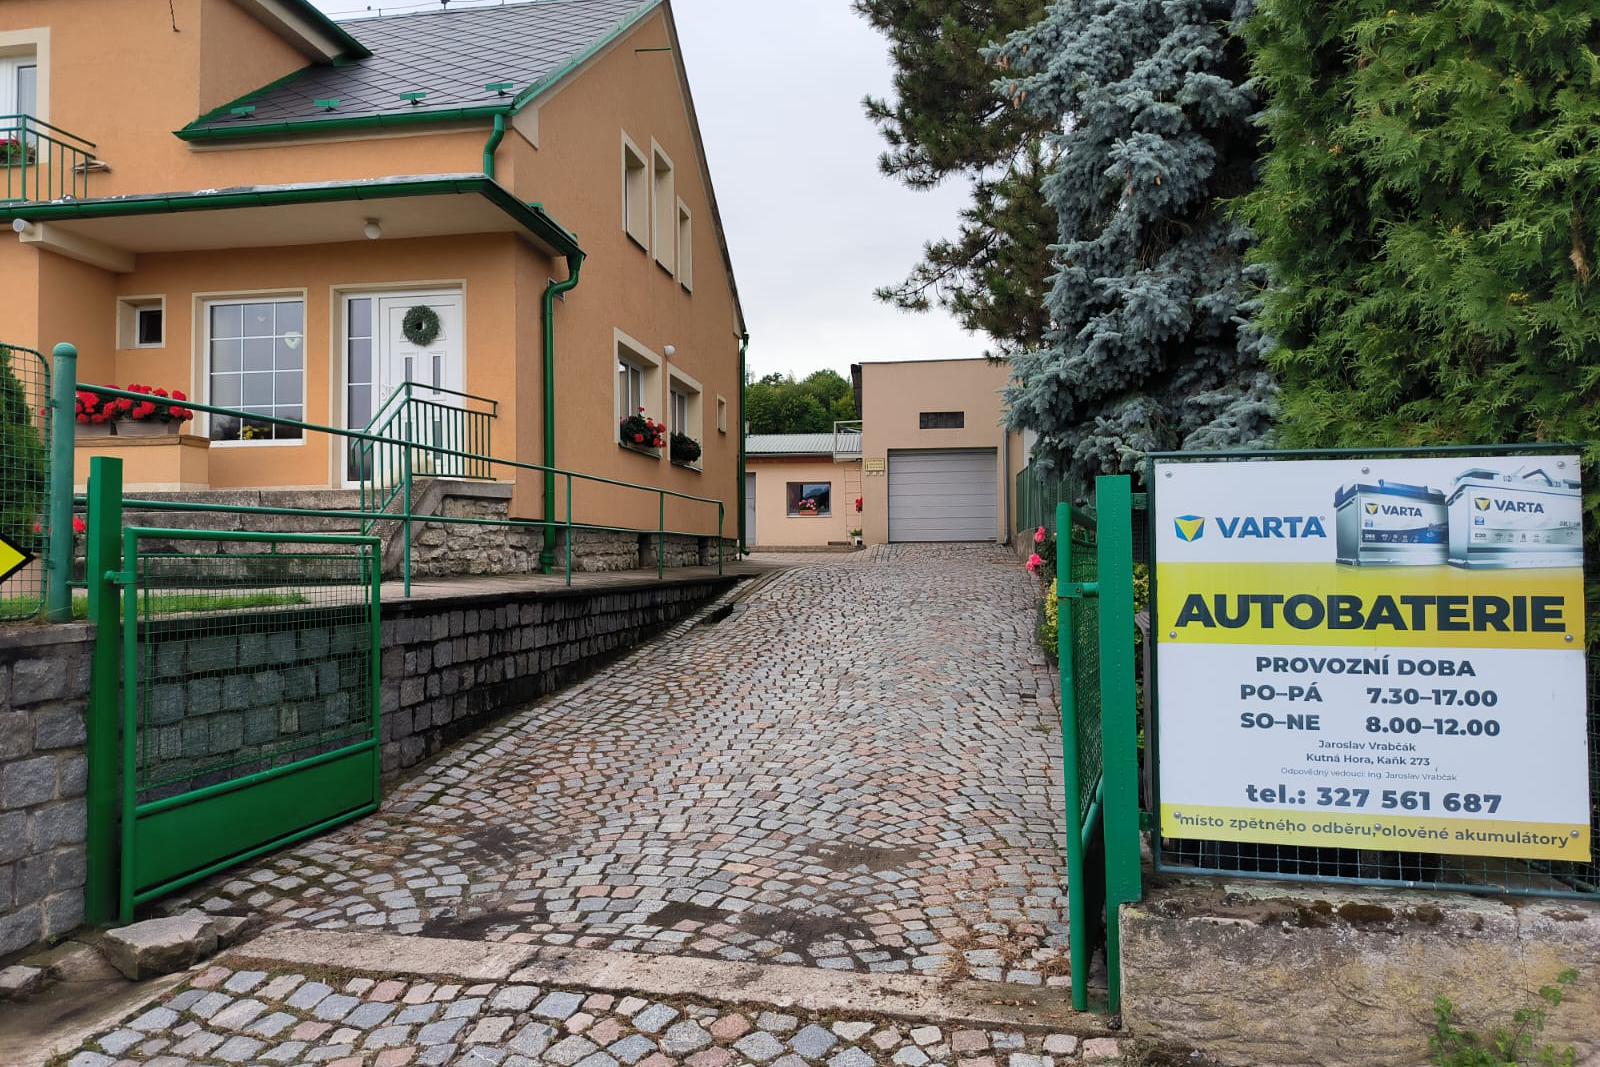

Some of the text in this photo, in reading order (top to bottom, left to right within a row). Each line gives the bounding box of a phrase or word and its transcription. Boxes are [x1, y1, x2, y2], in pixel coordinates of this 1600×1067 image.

[1381, 504, 1423, 517] VARTA
[1494, 499, 1545, 514] VARTA
[1215, 516, 1327, 539] VARTA
[1174, 593, 1567, 633] AUTOBATERIE
[1256, 655, 1477, 677] PROVOZNÍ DOBA
[1318, 740, 1417, 752] Jaroslav Vrabčák
[1306, 753, 1431, 766] Kutná Hora, Kaňk 273
[1246, 784, 1502, 814] tel.: 327 561 687
[1179, 813, 1224, 827] místo
[1229, 819, 1307, 832] zpětného
[1382, 825, 1449, 839] olověné
[1455, 829, 1569, 849] akumulátory
